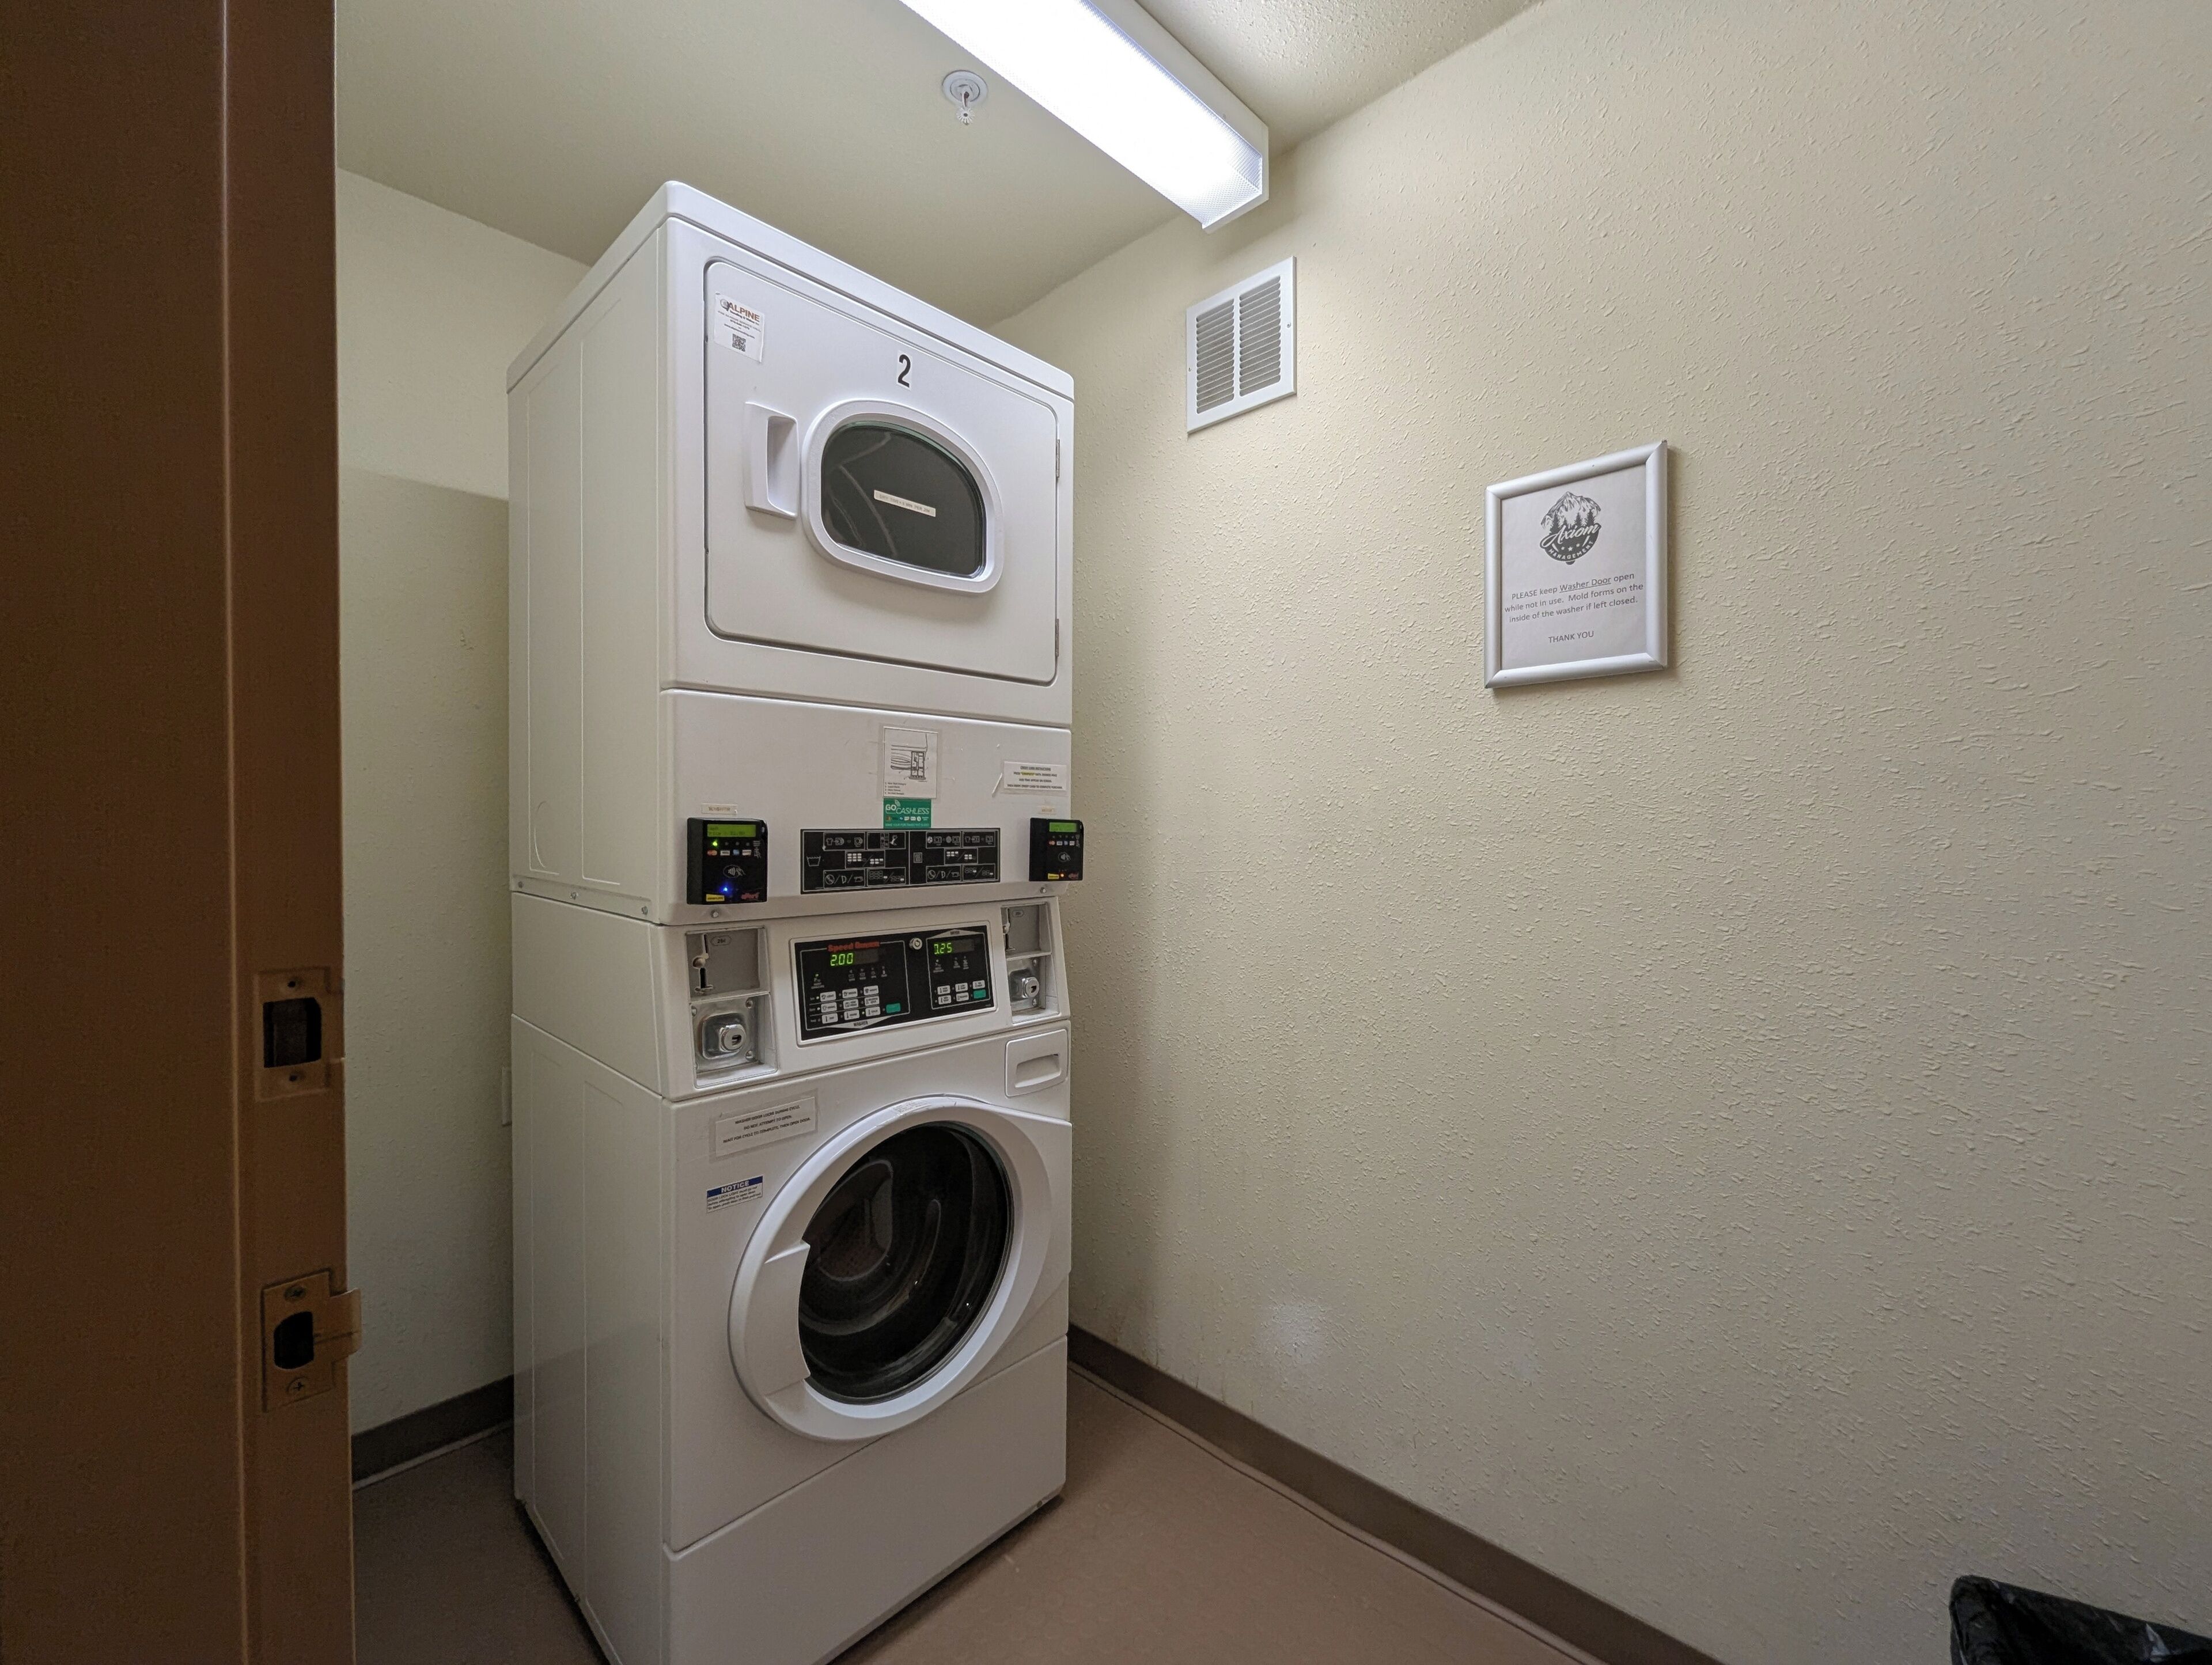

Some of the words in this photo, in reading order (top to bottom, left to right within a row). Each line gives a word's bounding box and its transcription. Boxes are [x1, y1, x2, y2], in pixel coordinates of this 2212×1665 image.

[728, 302, 760, 323] ALPINE
[897, 354, 911, 388] 2
[1541, 524, 1599, 548] Axiom
[1548, 541, 1593, 560] MANAGEMENT
[1512, 589, 1537, 600] PLEASE
[1540, 587, 1558, 596] keep
[1559, 581, 1589, 592] Washer
[1591, 577, 1612, 586] Door
[1613, 573, 1635, 583] open
[1505, 604, 1524, 613] while
[1568, 593, 1589, 602] Mold
[1591, 589, 1615, 598] forms
[1630, 583, 1643, 591] the
[1509, 614, 1530, 623] inside
[1542, 609, 1554, 617] the
[1556, 605, 1584, 616] washer
[1586, 603, 1592, 611] if
[1593, 601, 1607, 609] left
[1609, 596, 1638, 607] closed.
[1548, 634, 1575, 643] THANK
[1577, 631, 1594, 639] YOU
[828, 942, 854, 953] Speed
[830, 953, 854, 966] 2.00
[721, 1180, 749, 1193] NOTICE
